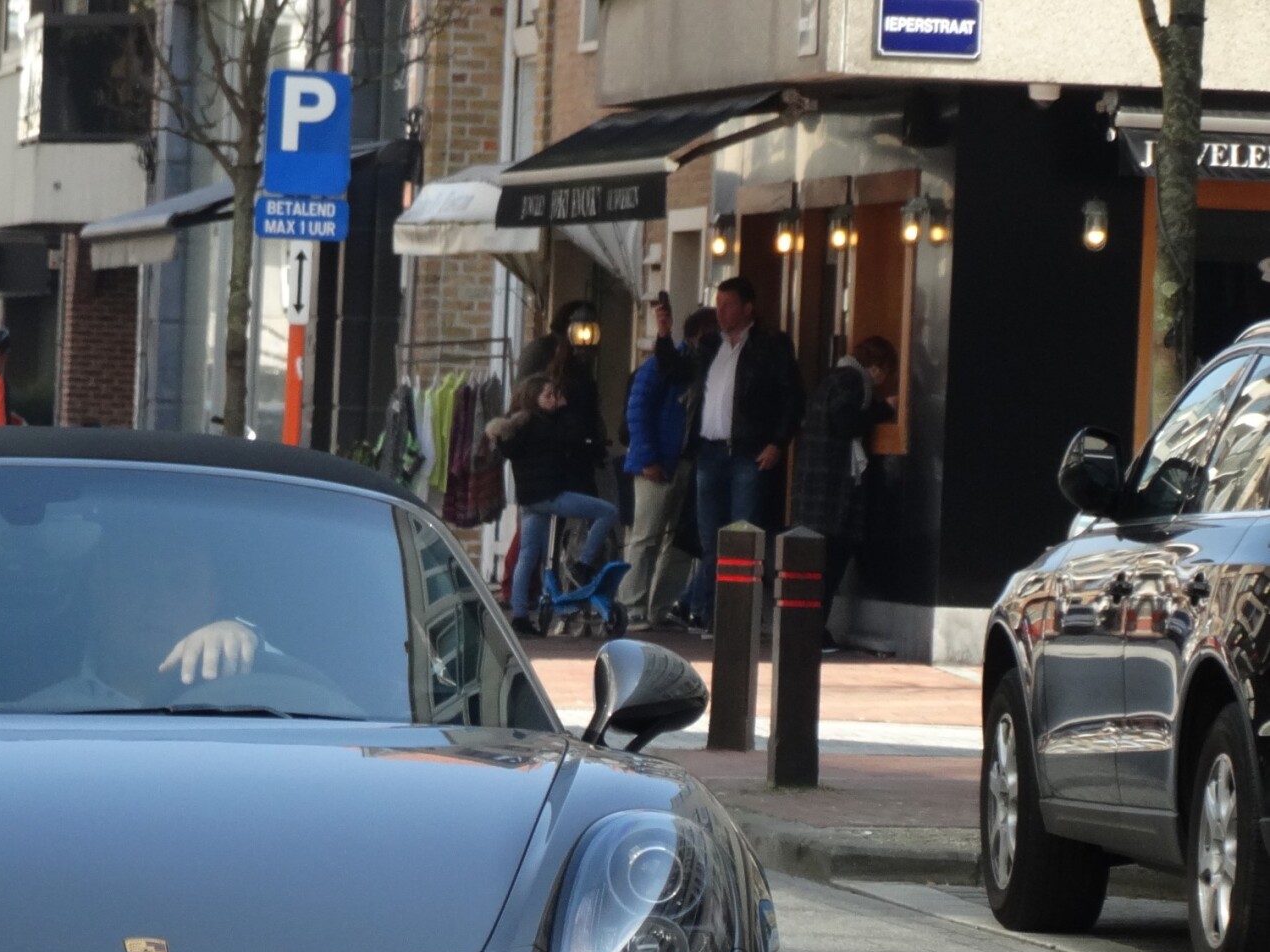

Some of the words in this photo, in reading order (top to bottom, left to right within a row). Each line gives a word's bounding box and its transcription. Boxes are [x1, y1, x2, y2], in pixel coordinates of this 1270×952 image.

[884, 15, 976, 35] IEPERSTRAAT
[281, 75, 336, 152] P
[266, 200, 336, 218] BETALEND
[264, 219, 296, 235] MAX
[299, 221, 305, 235] 1
[308, 221, 336, 236] UUR
